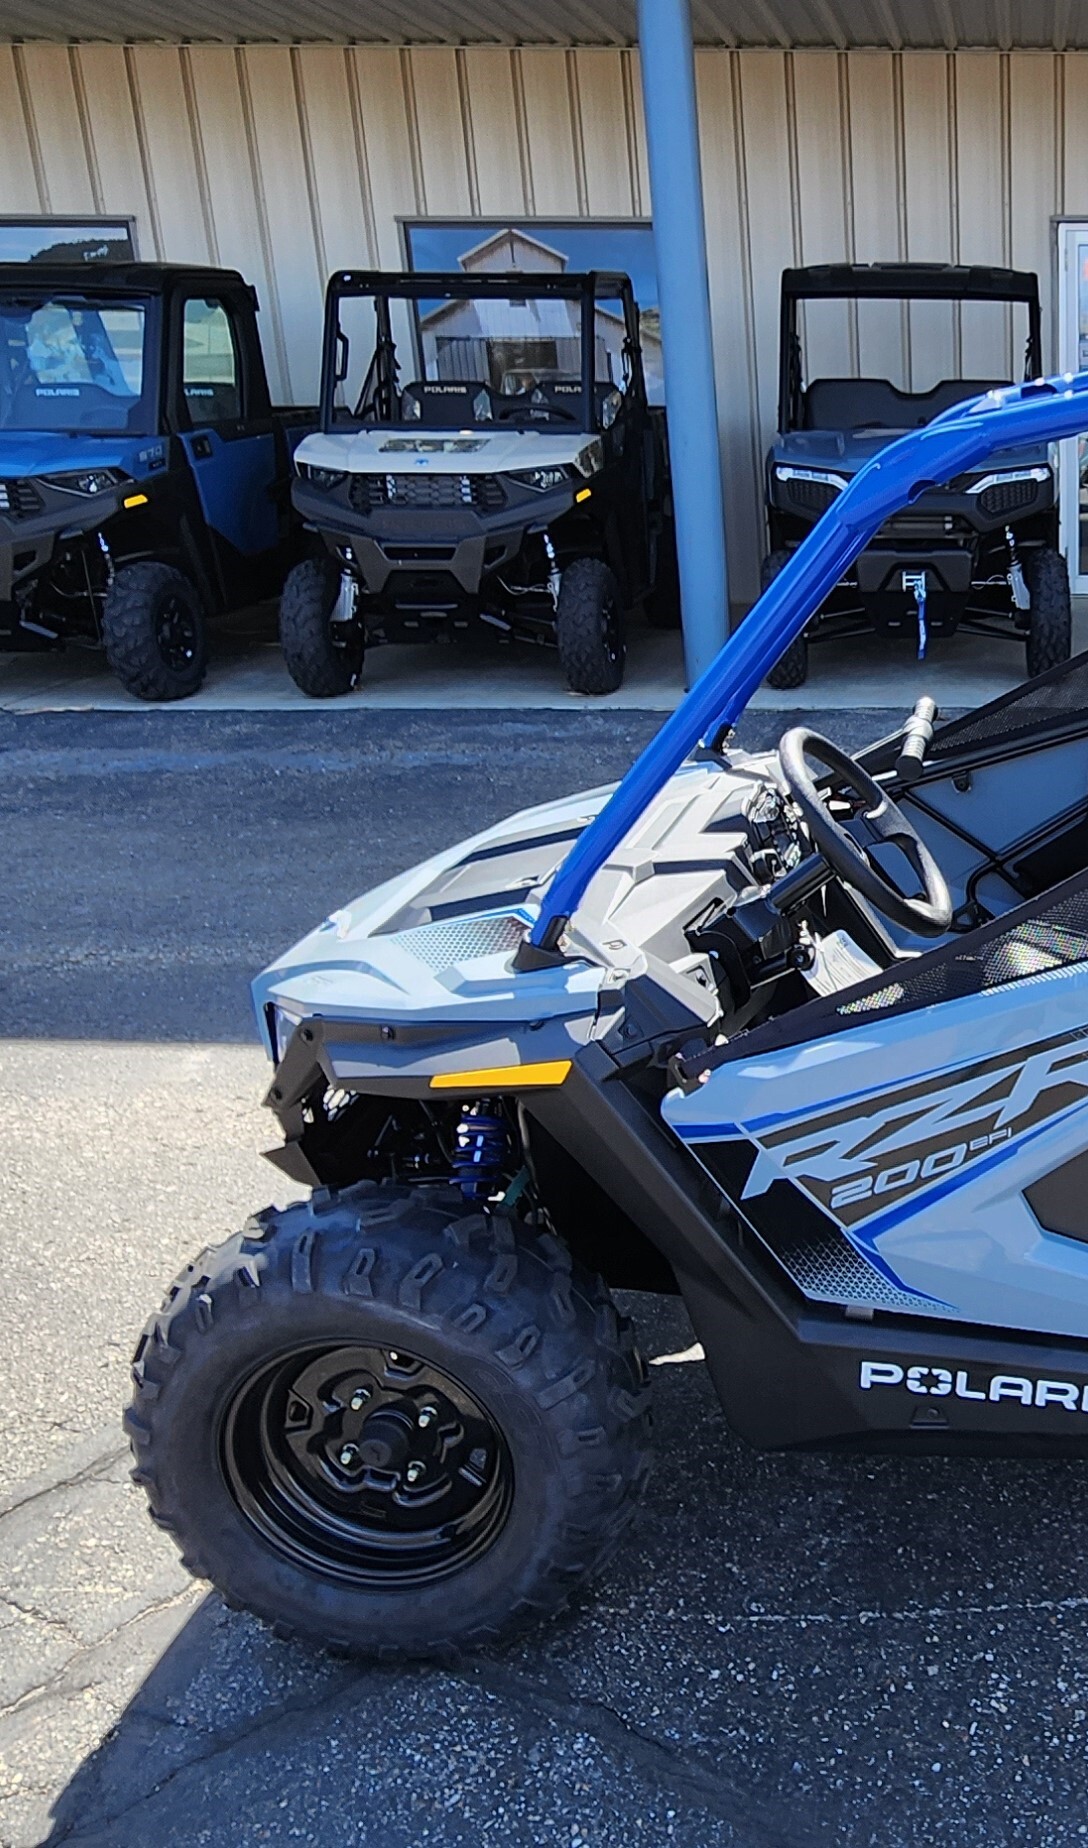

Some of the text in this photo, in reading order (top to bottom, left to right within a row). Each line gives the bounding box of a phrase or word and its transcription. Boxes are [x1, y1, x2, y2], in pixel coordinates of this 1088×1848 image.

[35, 388, 80, 397] POLARIS
[184, 388, 214, 396] LARIS
[423, 385, 467, 394] POLARIS
[554, 385, 582, 394] POLA
[831, 1126, 1013, 1209] 200 EFI
